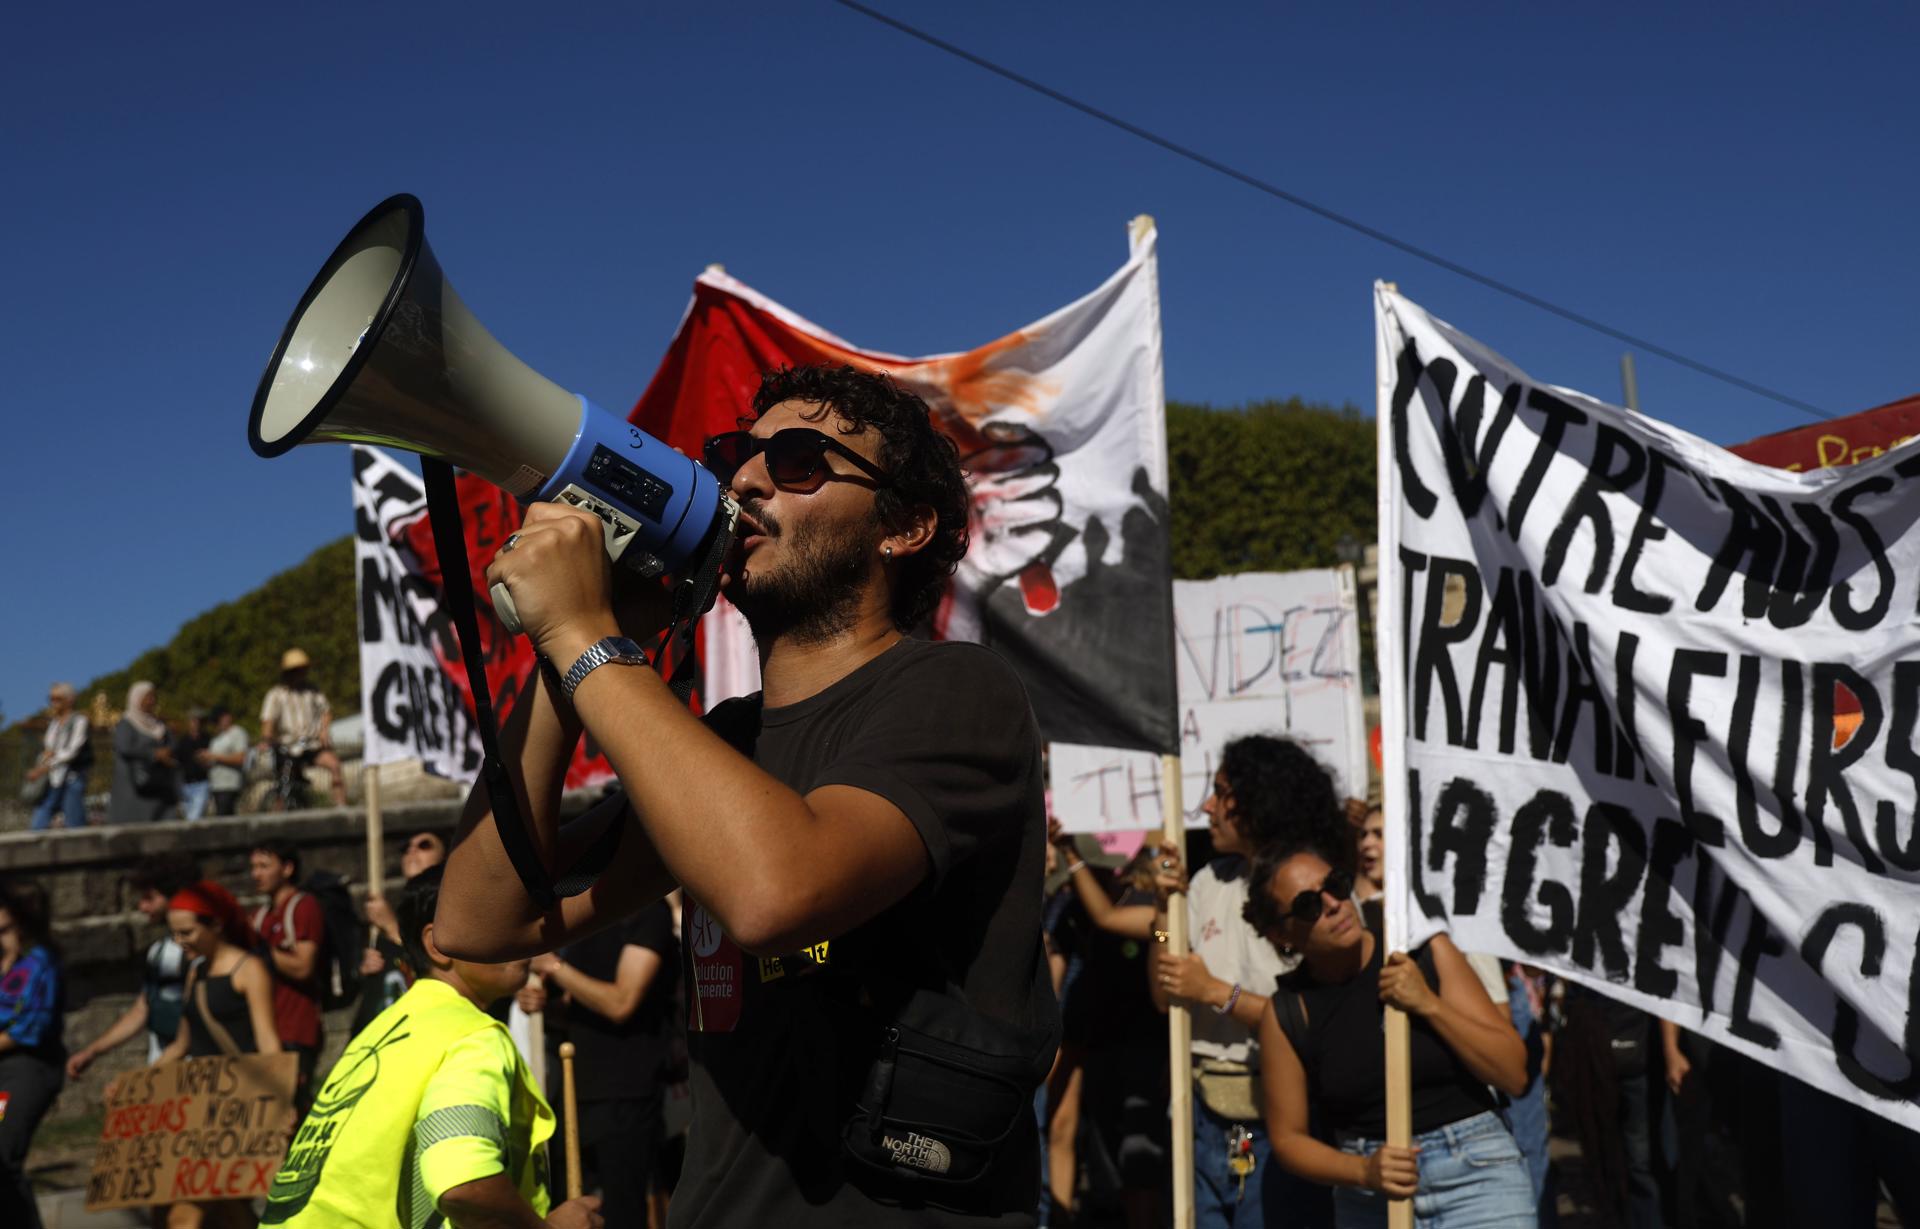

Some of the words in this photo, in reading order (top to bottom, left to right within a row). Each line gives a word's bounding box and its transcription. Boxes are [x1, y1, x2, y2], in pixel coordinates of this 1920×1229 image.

[630, 428, 643, 449] 3
[1175, 604, 1354, 701] NDEZ
[1408, 769, 1498, 920] LA
[697, 962, 733, 981] olution
[700, 983, 732, 998] anente
[881, 1135, 930, 1160] NORTH
[907, 1131, 934, 1150] THE
[891, 1151, 927, 1169] FACE
[172, 1157, 273, 1198] ROLEX
